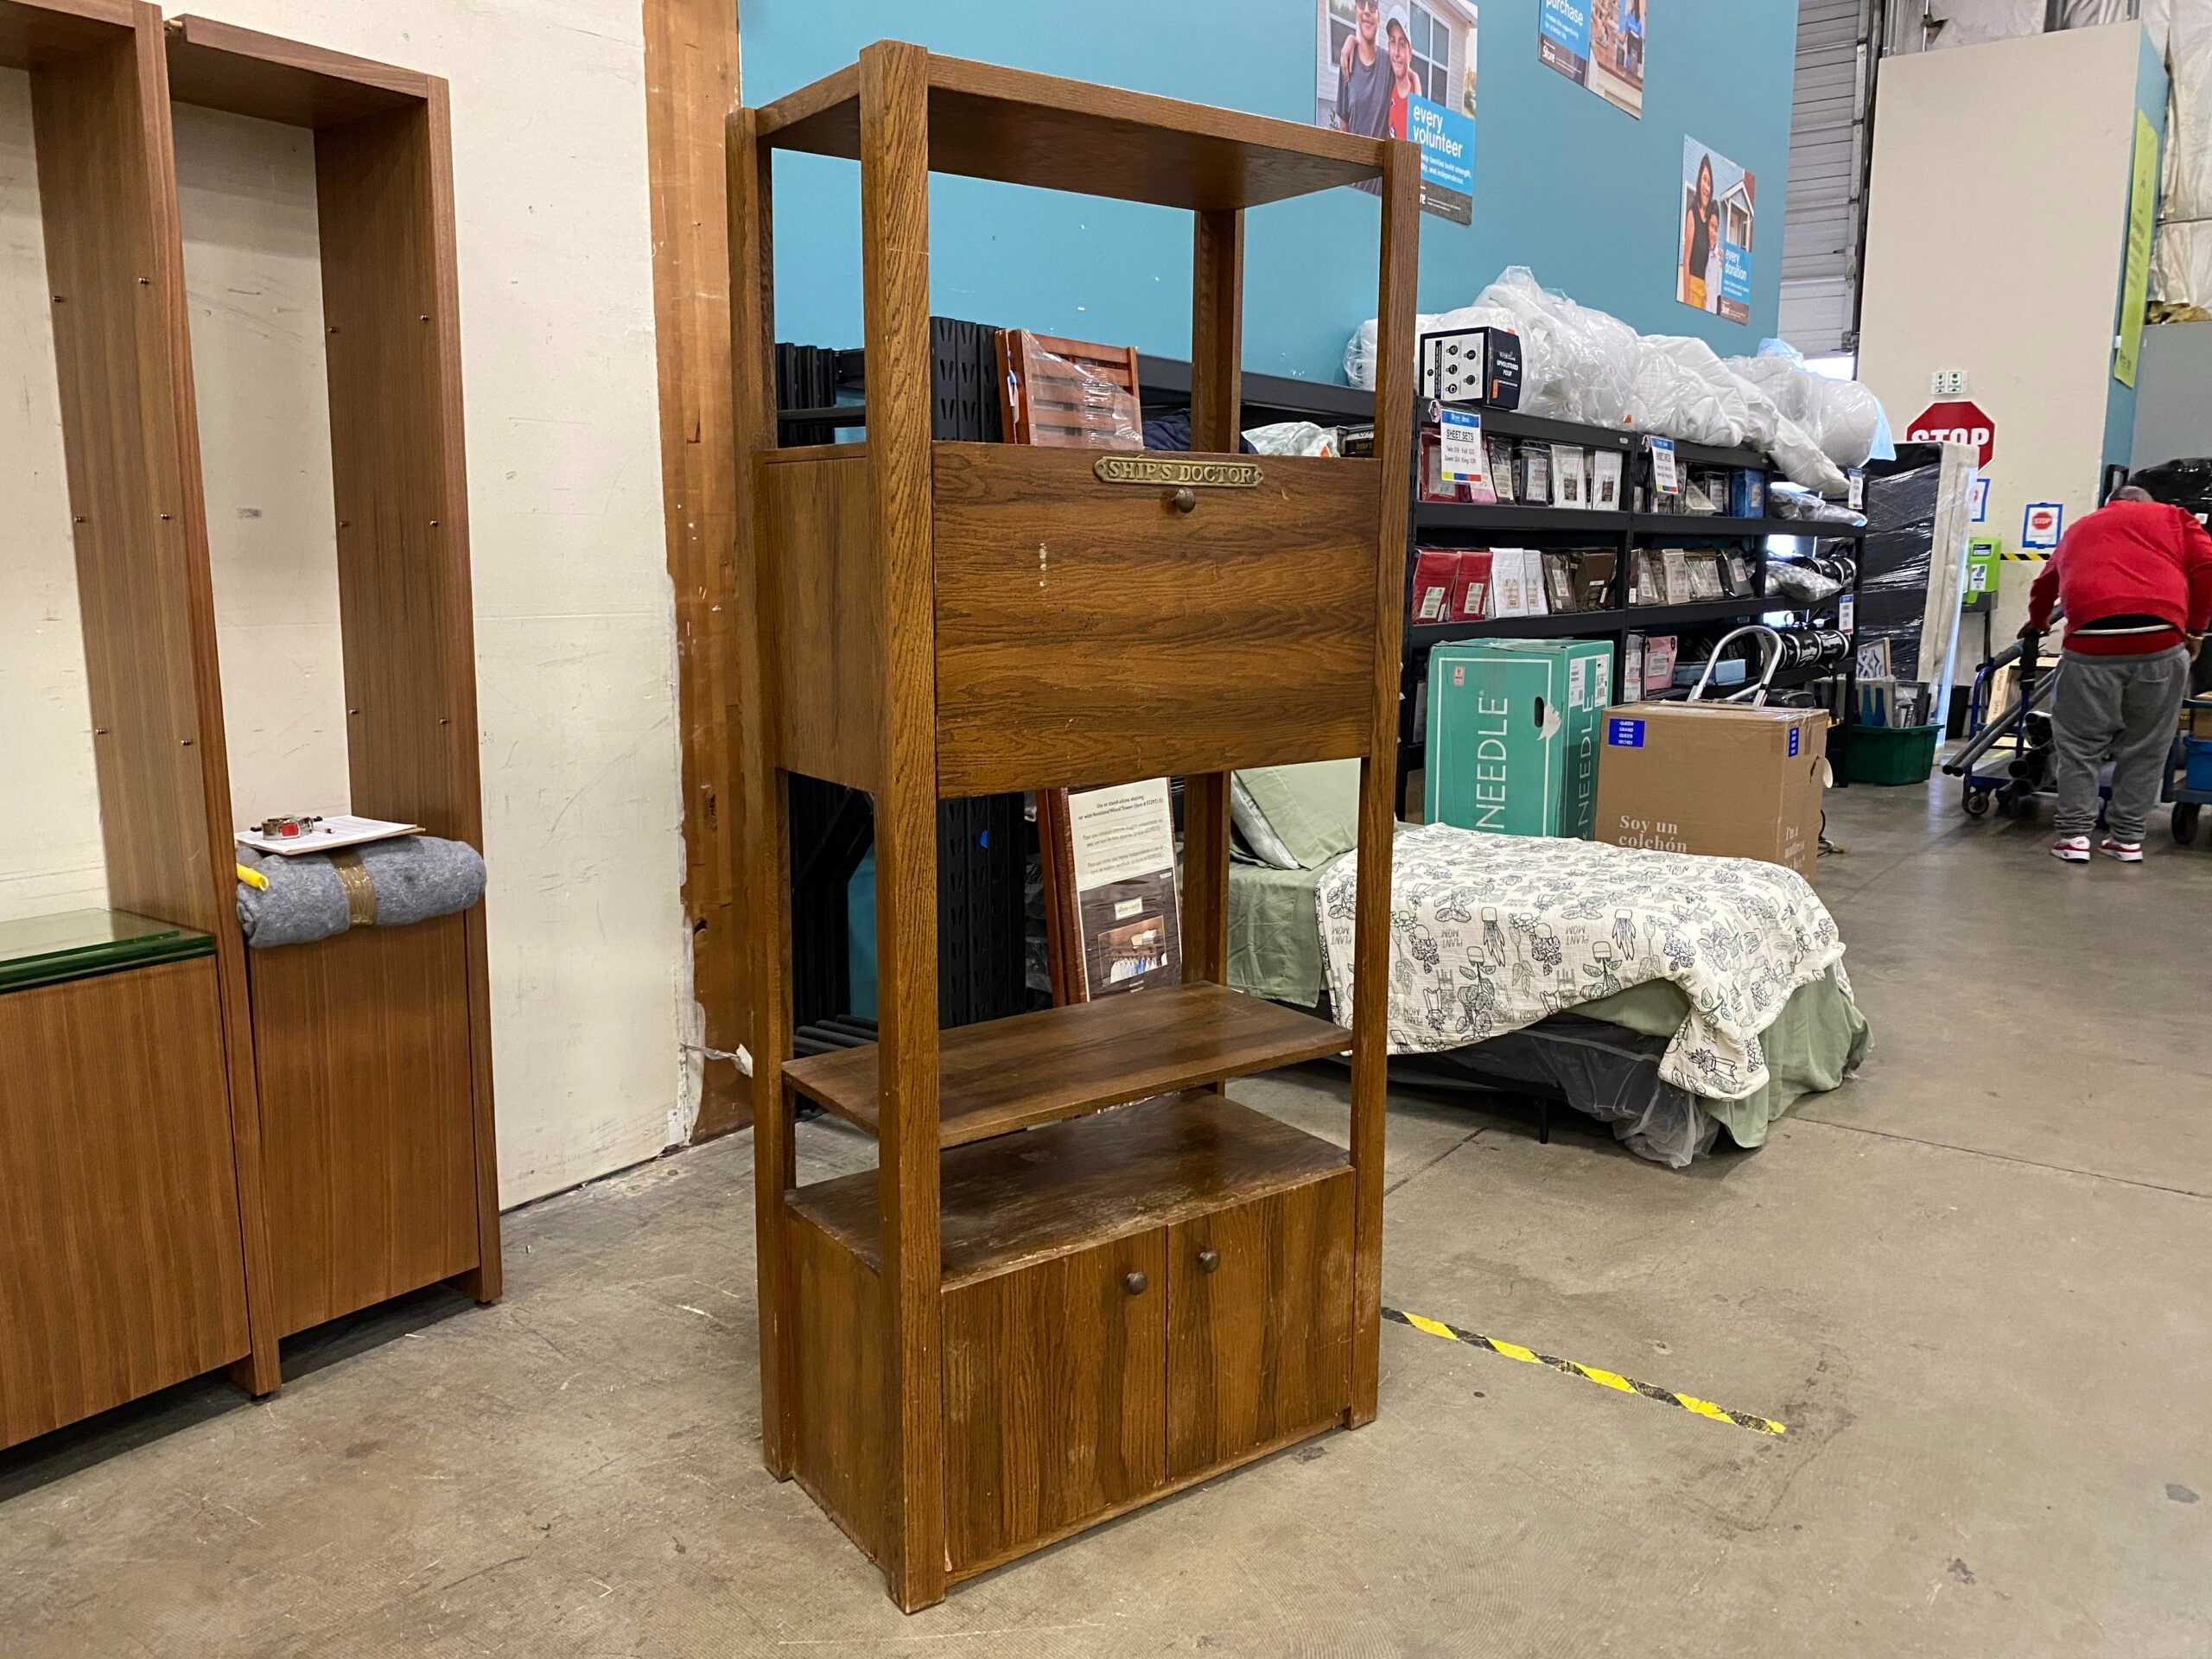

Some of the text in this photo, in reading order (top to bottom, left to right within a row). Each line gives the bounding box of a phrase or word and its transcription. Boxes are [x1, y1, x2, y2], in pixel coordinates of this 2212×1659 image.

[1413, 105, 1443, 133] every
[1413, 124, 1463, 158] volunteer
[1446, 429, 1474, 441] SHEET SETS
[1108, 461, 1253, 484] SHIP'S DOCTOR
[1476, 696, 1508, 829] NEEDLE
[1578, 694, 1593, 826] NEEDLE
[1619, 815, 1678, 835] Soy un
[1618, 833, 1687, 853] colchón
[1332, 925, 1350, 934] MOM
[1441, 929, 1459, 938] MOM
[1566, 925, 1586, 935] MOM
[1331, 935, 1352, 945] PLANT
[1442, 938, 1463, 948] PLANT
[1566, 935, 1590, 945] PLANT
